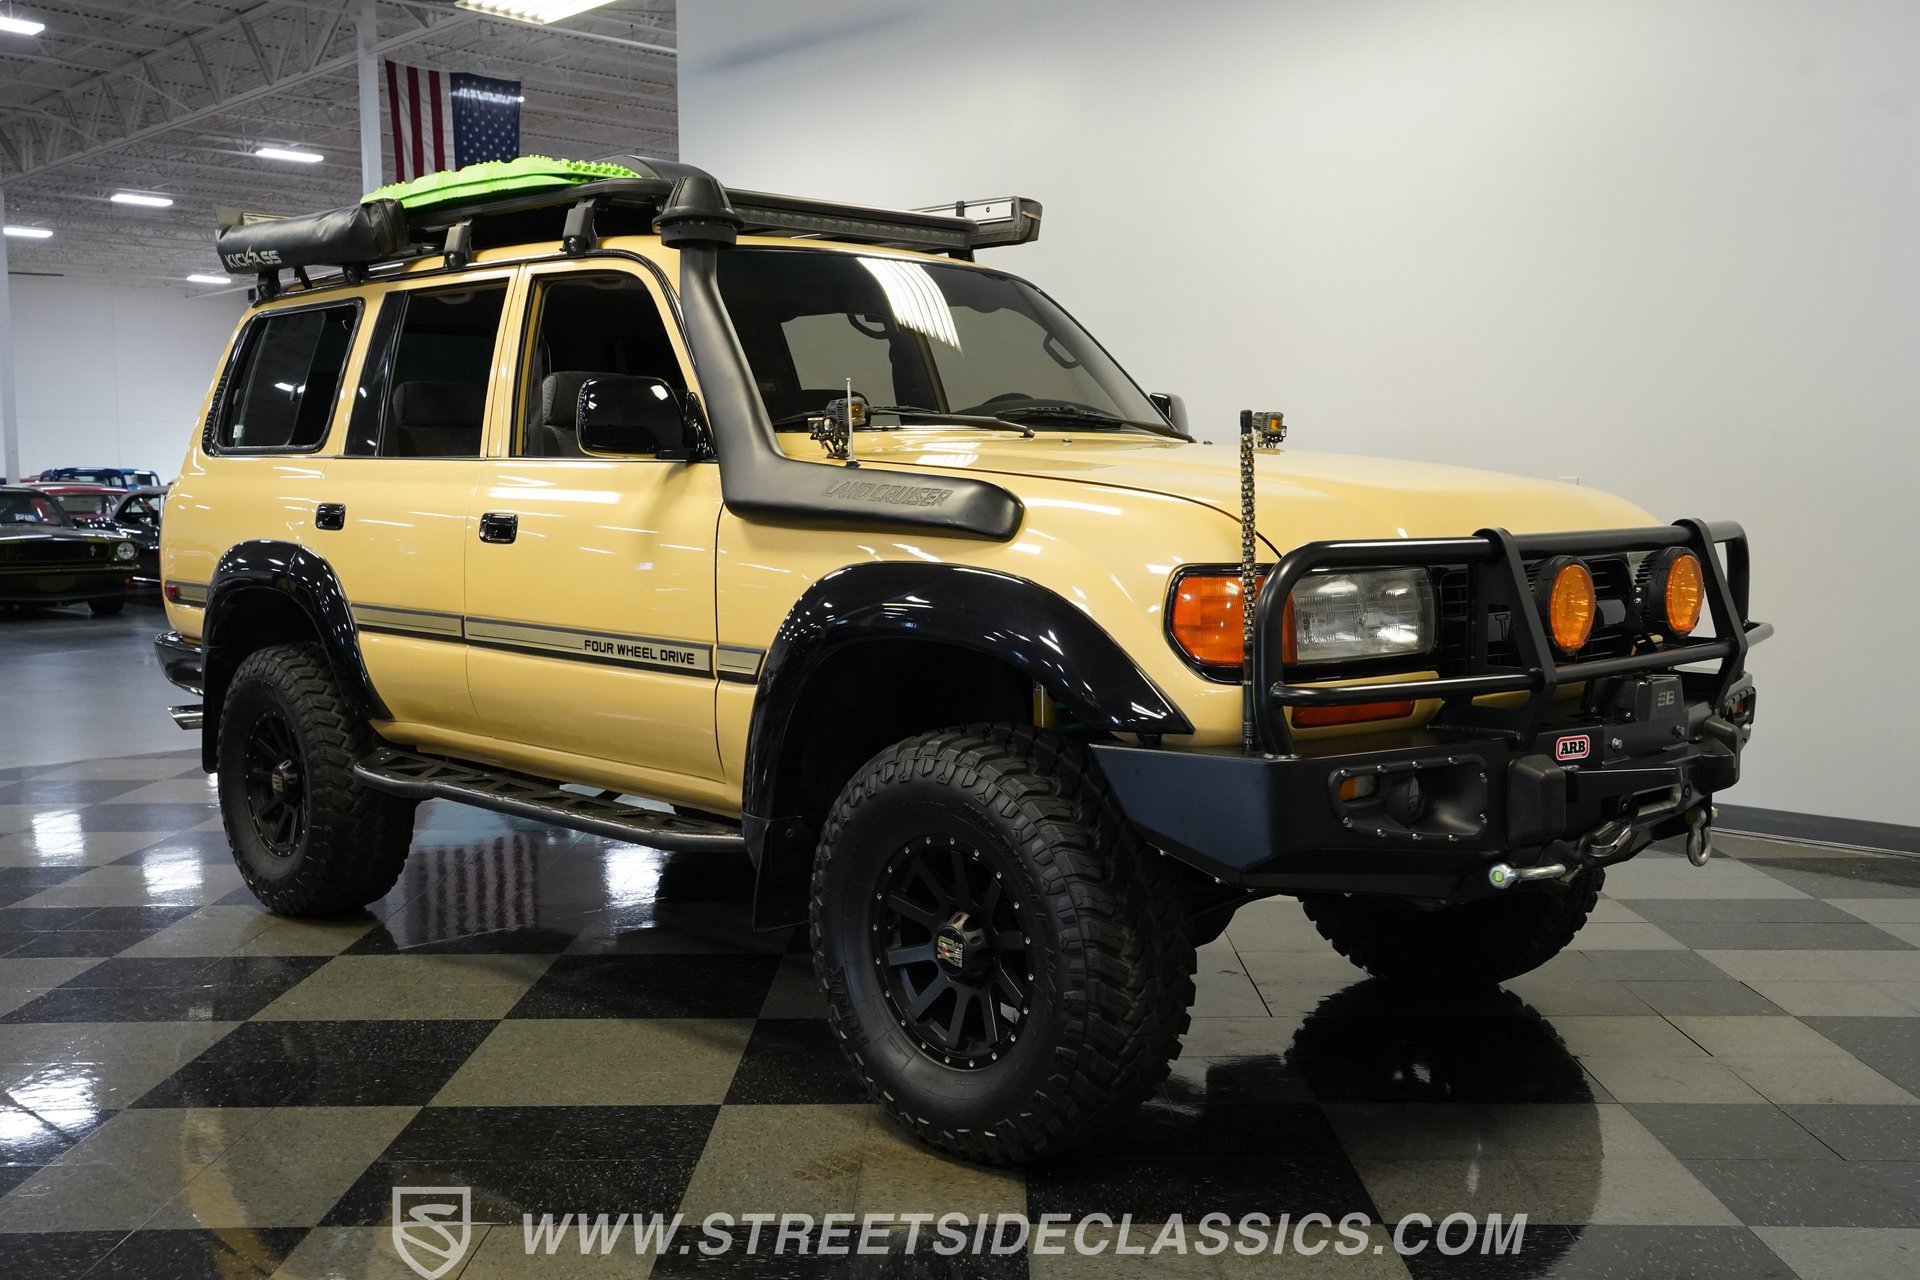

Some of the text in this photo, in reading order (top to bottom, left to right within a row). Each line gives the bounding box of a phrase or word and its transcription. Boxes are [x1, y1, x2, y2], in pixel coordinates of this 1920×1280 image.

[584, 639, 695, 666] FOUR WHEEL DRIVE
[1560, 740, 1586, 755] ARB
[954, 942, 964, 968] SERIES
